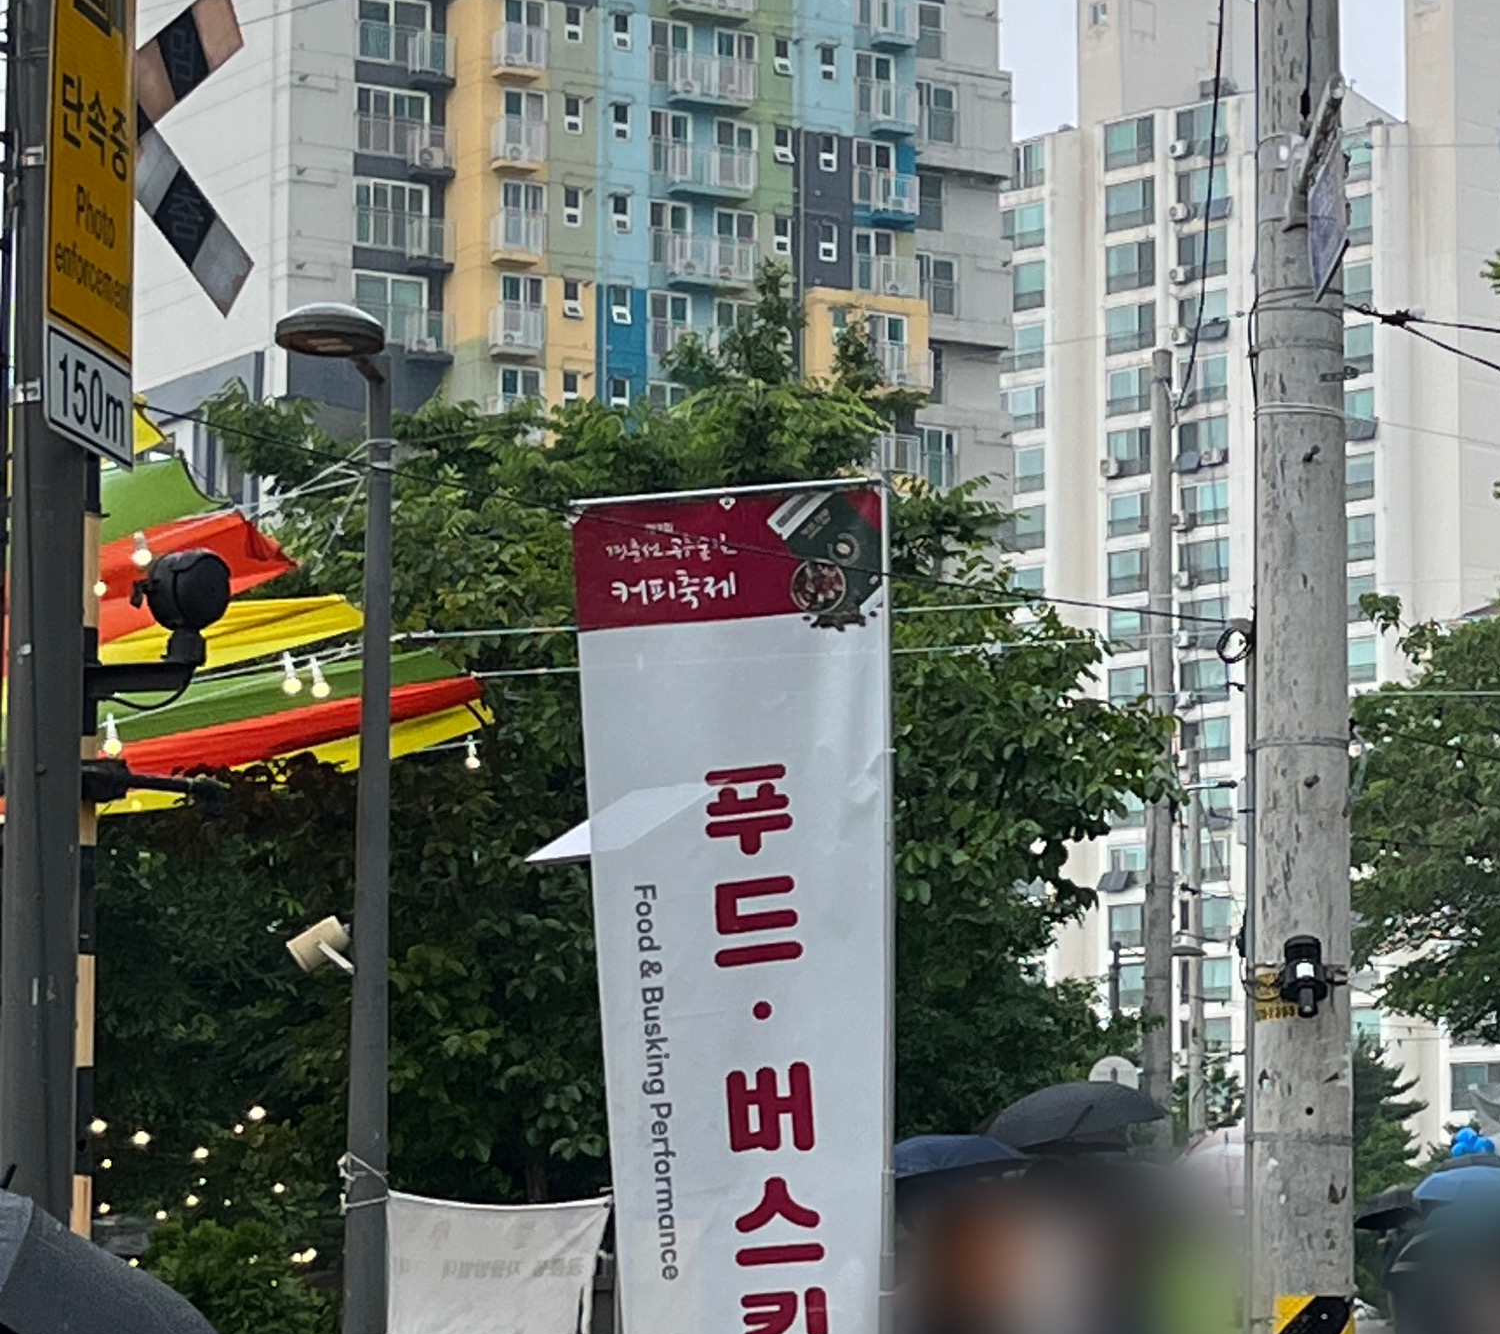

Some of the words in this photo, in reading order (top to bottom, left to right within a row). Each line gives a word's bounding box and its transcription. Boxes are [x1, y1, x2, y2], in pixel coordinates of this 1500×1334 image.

[62, 72, 129, 182] 단속중
[76, 183, 116, 250] Photo
[58, 352, 125, 448] 150m
[611, 570, 737, 609] 커피축제
[633, 883, 662, 954] Food
[639, 959, 663, 980] &
[641, 985, 670, 1097] Busking
[650, 1101, 680, 1281] Performance
